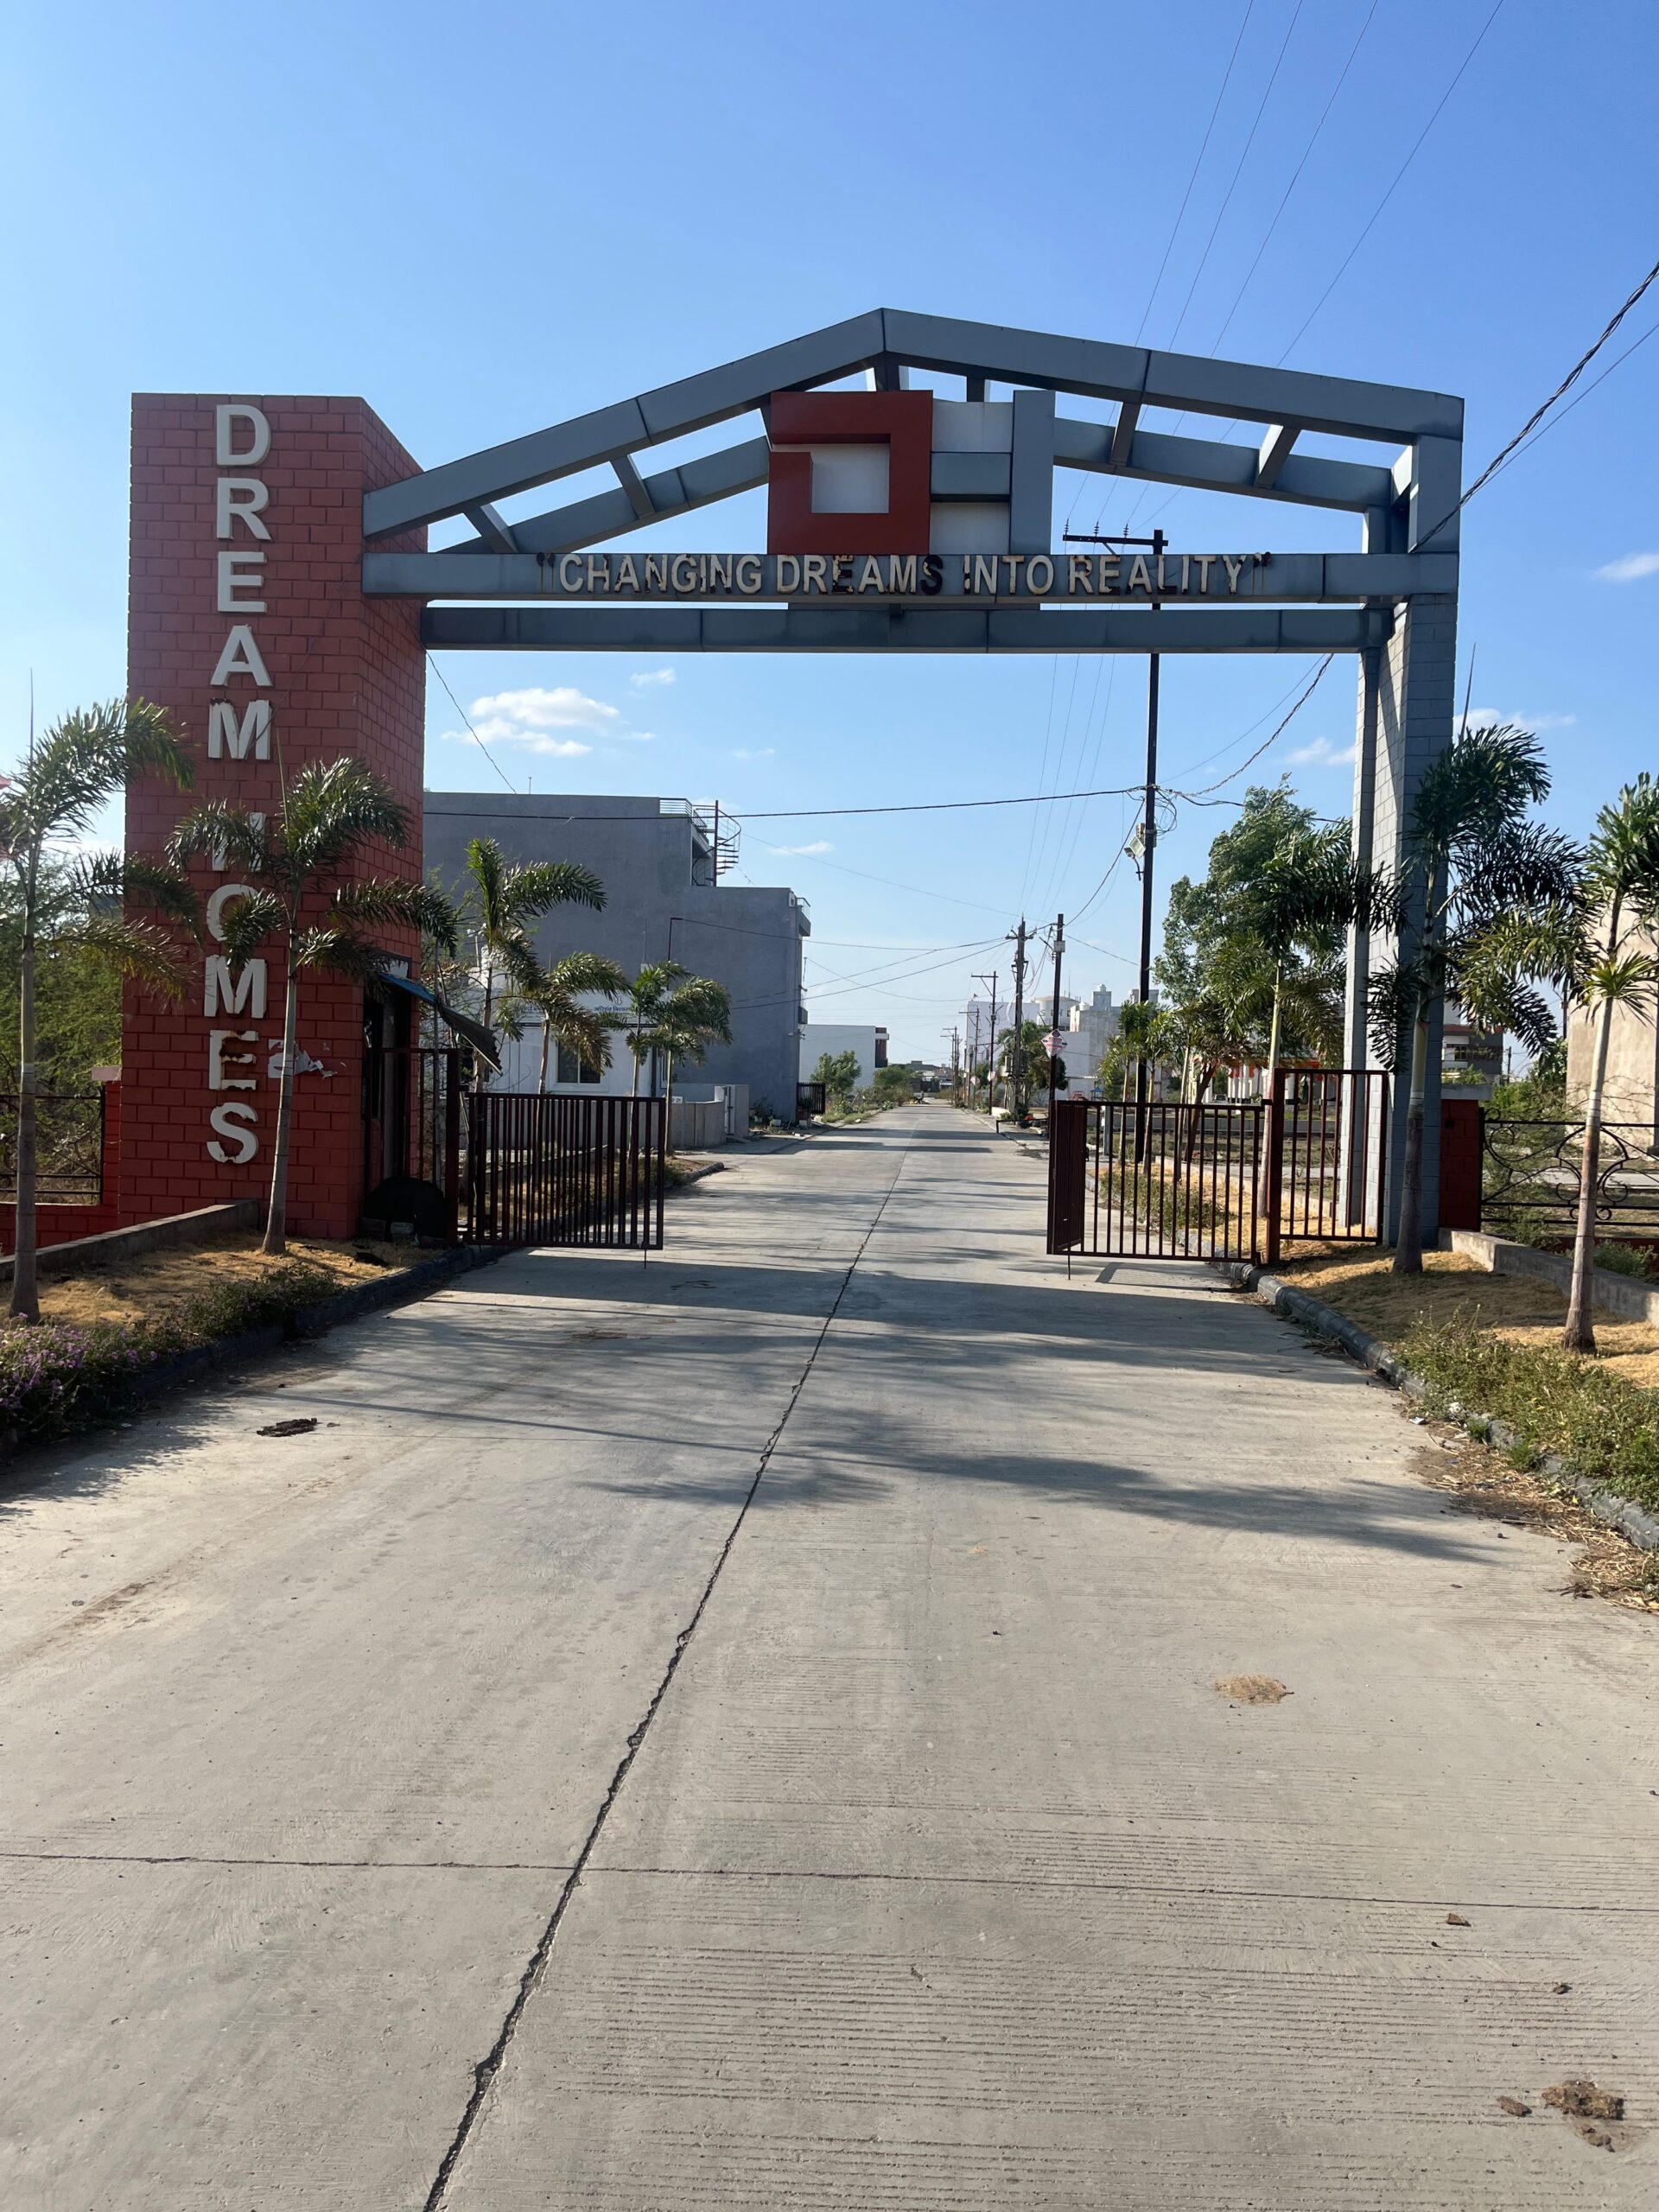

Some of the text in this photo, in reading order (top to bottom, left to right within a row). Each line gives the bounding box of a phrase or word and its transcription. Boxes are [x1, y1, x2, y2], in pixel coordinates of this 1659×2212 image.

[207, 404, 273, 760] DREAM
[776, 553, 944, 595] DREAMS
[963, 554, 1053, 595] INTO
